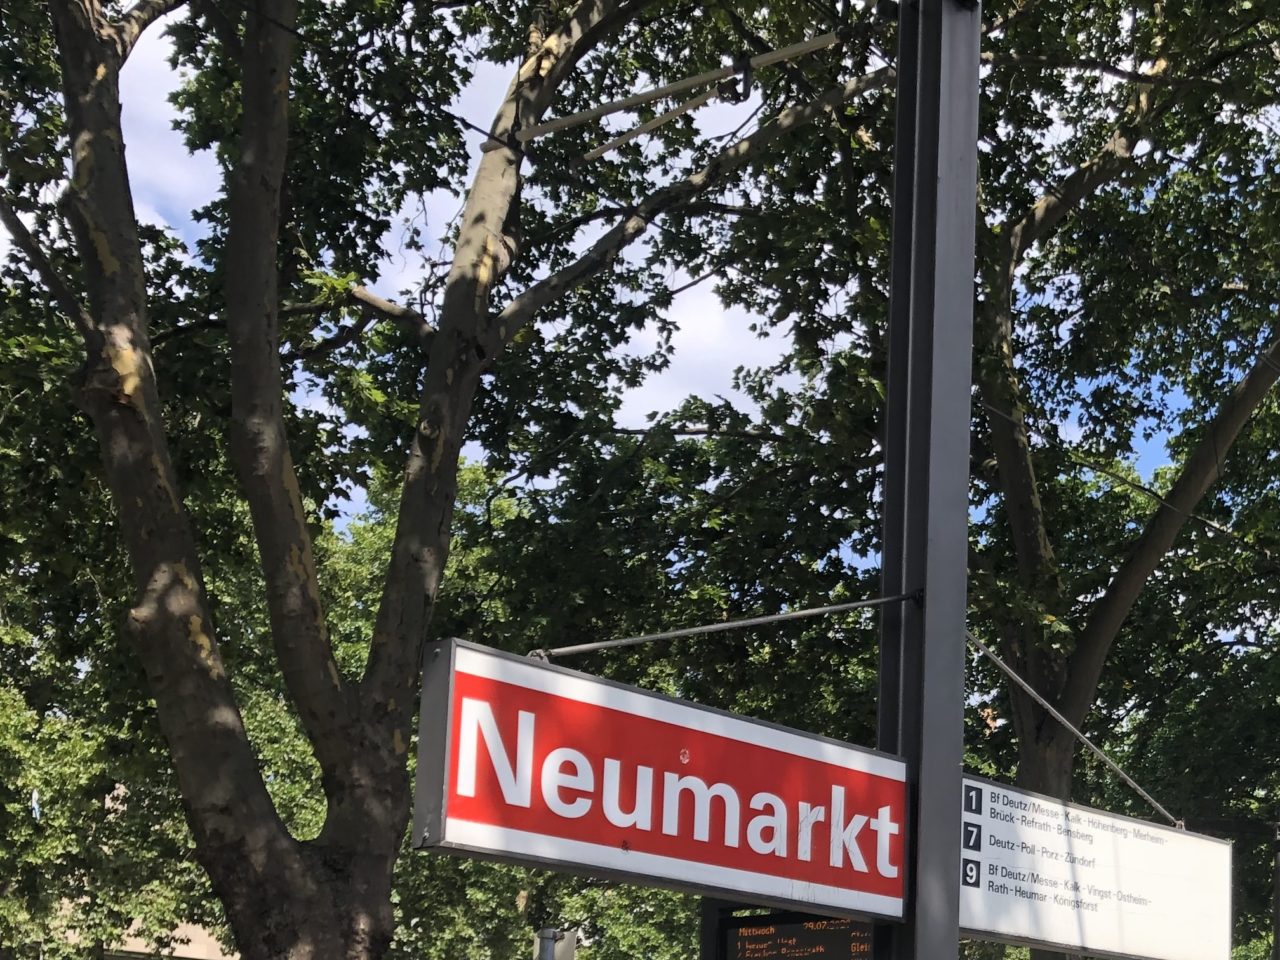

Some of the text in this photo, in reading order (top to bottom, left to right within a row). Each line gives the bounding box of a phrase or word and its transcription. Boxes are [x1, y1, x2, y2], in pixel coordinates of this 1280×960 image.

[456, 697, 900, 878] Neumarkt
[969, 790, 976, 811] 1
[990, 791, 1000, 803] Bf
[1002, 795, 1059, 817] Deutz/Messe
[967, 826, 978, 847] 7
[989, 807, 1094, 845] Brück Refrath Bensberg
[989, 834, 1096, 868] Deutz Poll Porz Zündorf
[966, 863, 977, 884] 9
[988, 863, 998, 876] Bf
[1001, 866, 1058, 888] Deutz/Messe
[738, 926, 775, 937] Mittwoch
